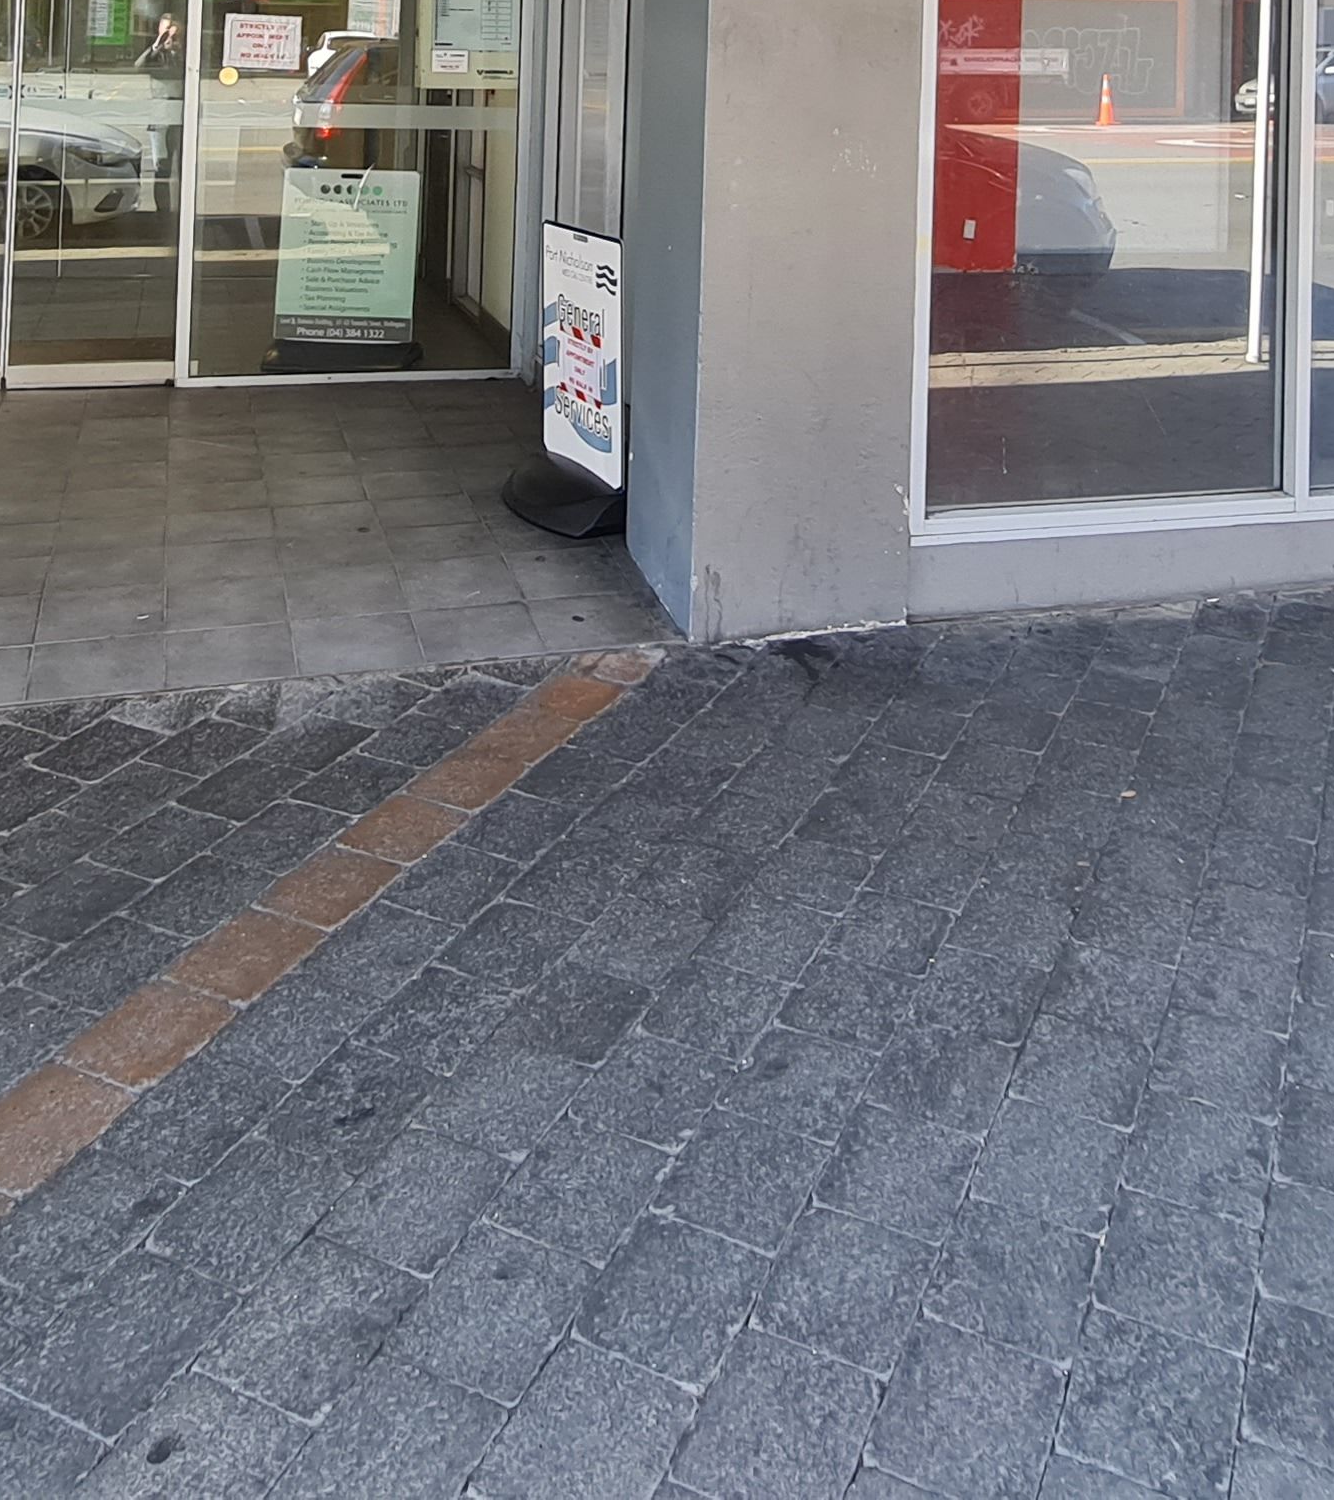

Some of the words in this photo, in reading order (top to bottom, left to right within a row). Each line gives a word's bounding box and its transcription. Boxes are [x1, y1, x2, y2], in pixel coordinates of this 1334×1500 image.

[236, 32, 289, 41] APPOINMENT
[559, 248, 593, 272] Nicholson
[557, 293, 605, 338] General
[296, 327, 325, 336] Phone
[327, 327, 343, 337] (04)
[346, 328, 362, 337] 384
[363, 329, 385, 338] 1322
[555, 385, 610, 440] Services
